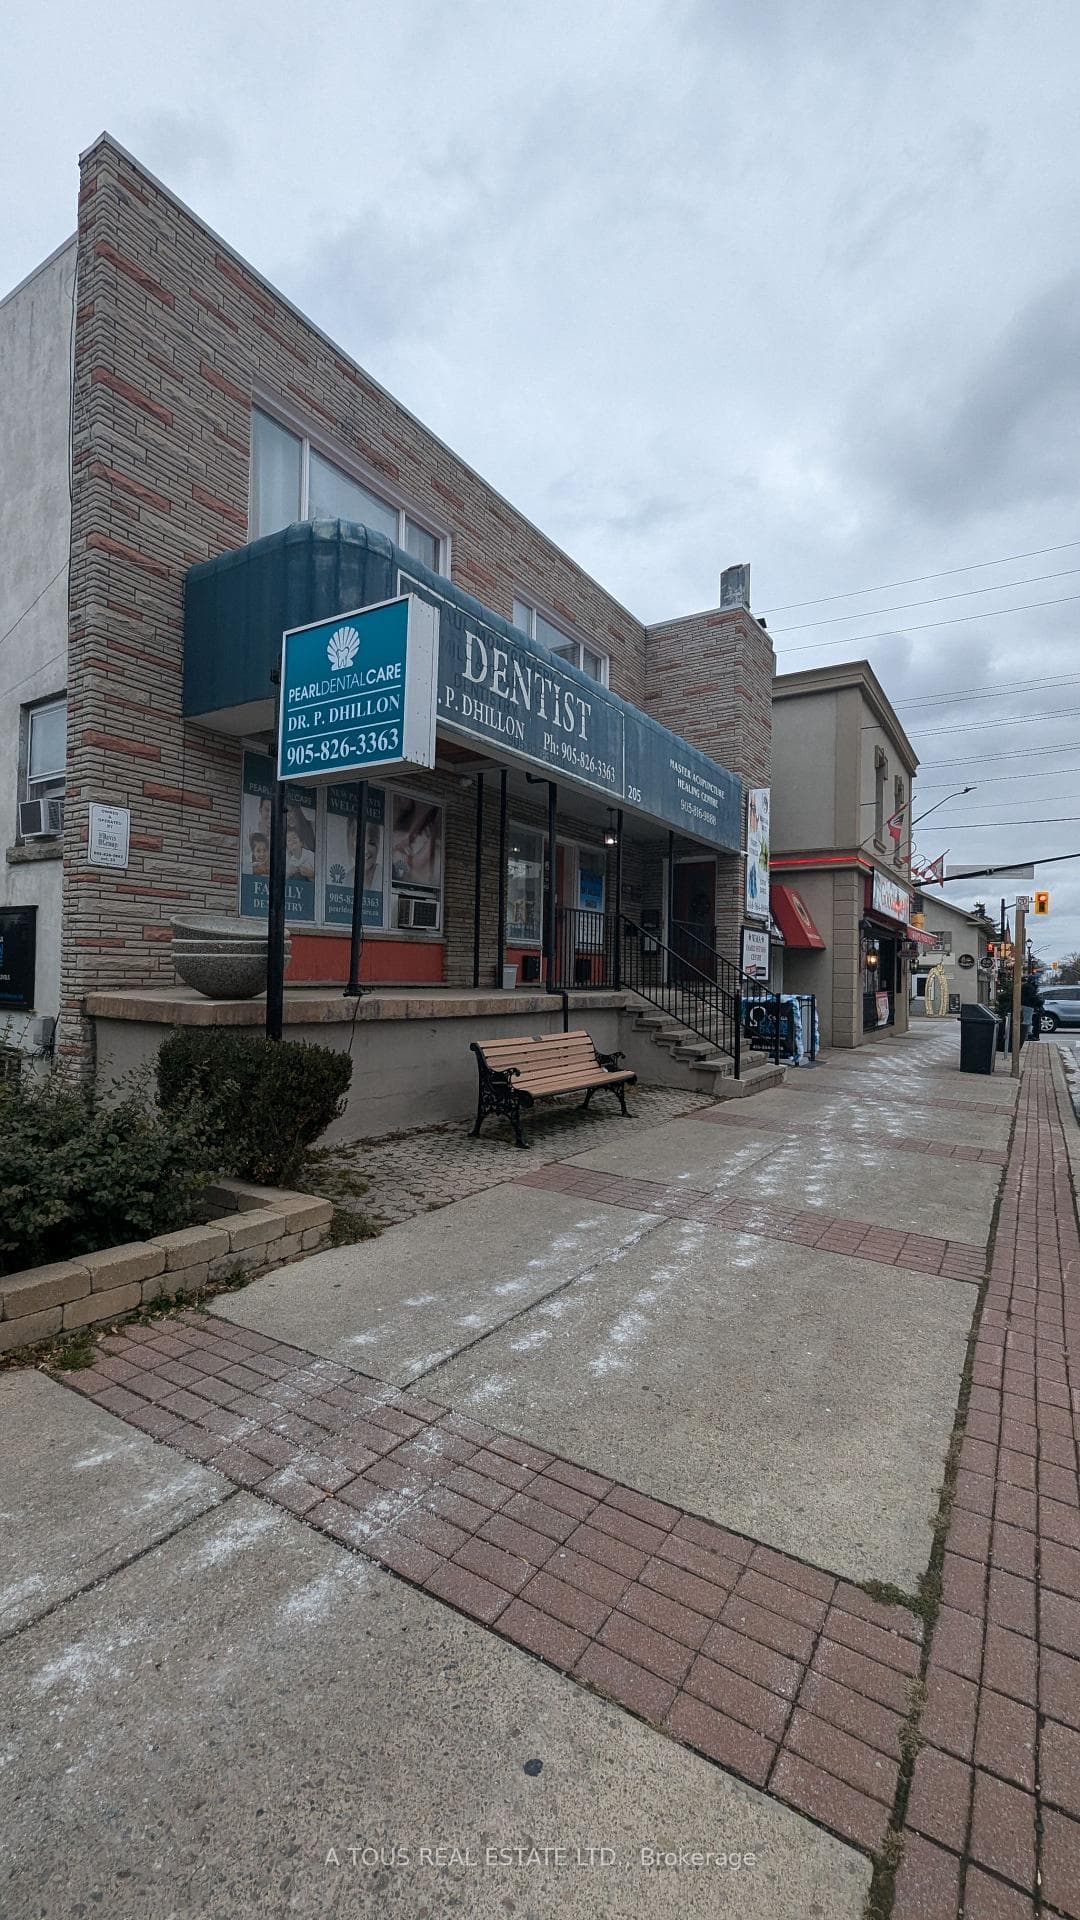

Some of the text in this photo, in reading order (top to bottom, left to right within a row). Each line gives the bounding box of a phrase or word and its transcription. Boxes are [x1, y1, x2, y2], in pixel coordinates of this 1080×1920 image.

[288, 662, 401, 703] PEARLDENTALCARE
[461, 629, 592, 741] DENTIST
[288, 694, 401, 732] DR. P. DHILLON
[287, 727, 399, 767] 905-826-3363
[445, 685, 459, 711] P.
[461, 693, 526, 741] DHILLON
[543, 731, 559, 756] Ph:
[561, 742, 616, 783] 905-826-3363
[669, 759, 692, 780] MASTER
[677, 777, 700, 799] HEALING
[627, 784, 642, 803] 205
[253, 881, 304, 899] FALY
